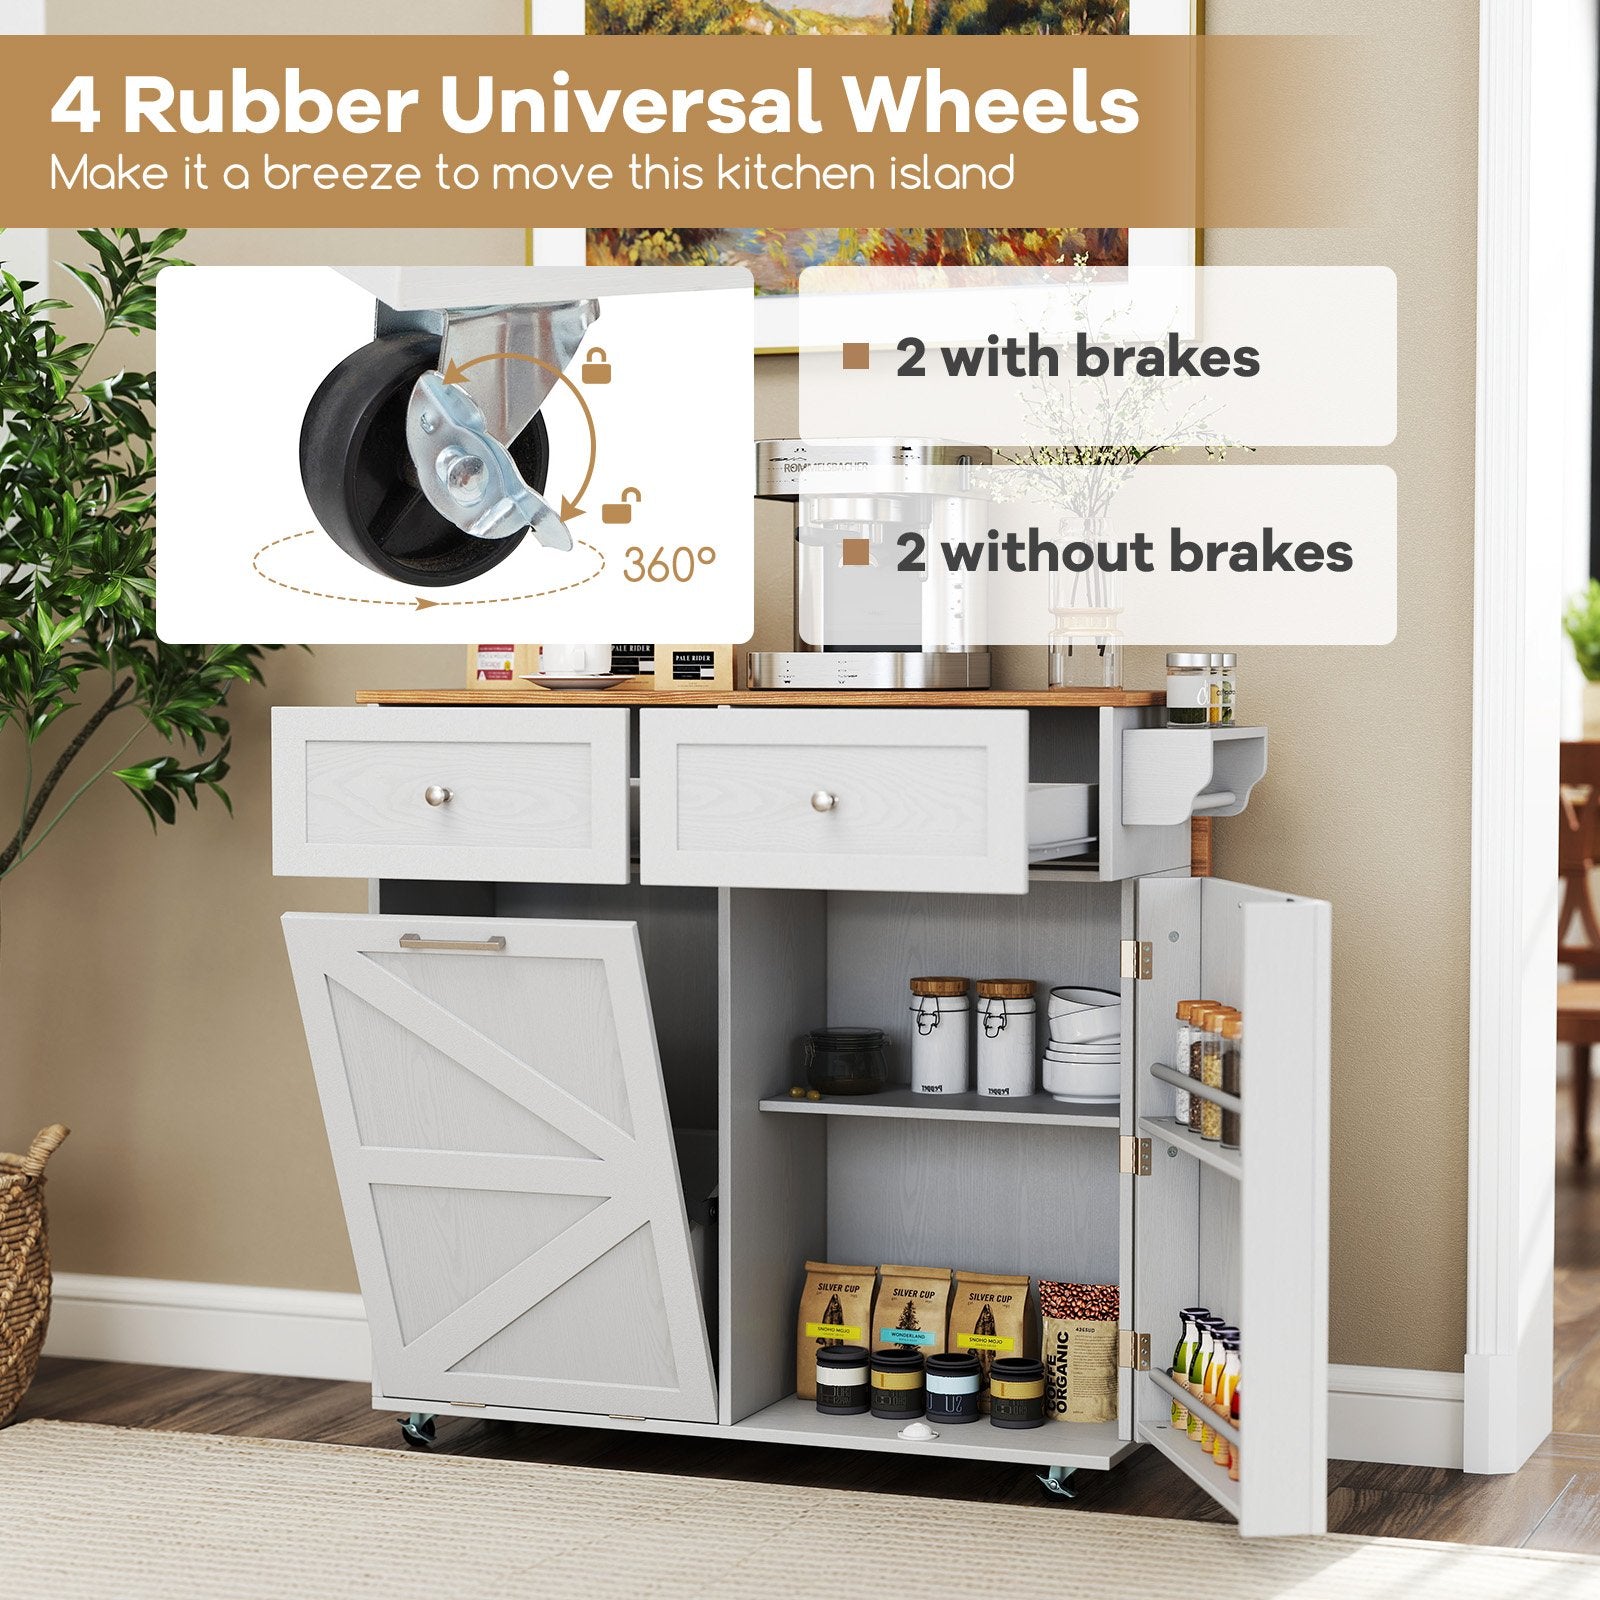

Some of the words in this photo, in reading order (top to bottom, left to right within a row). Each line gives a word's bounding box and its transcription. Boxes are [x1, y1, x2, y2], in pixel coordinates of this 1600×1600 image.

[818, 1282, 843, 1292] SILVER
[844, 1284, 860, 1293] CUP
[893, 1288, 919, 1298] SILVER
[919, 1290, 936, 1299] CUP
[969, 1292, 995, 1302] SILVER
[996, 1295, 1013, 1303] CUP
[891, 1332, 926, 1340] WONDERLAND
[1056, 1331, 1069, 1414] ORGANIC
